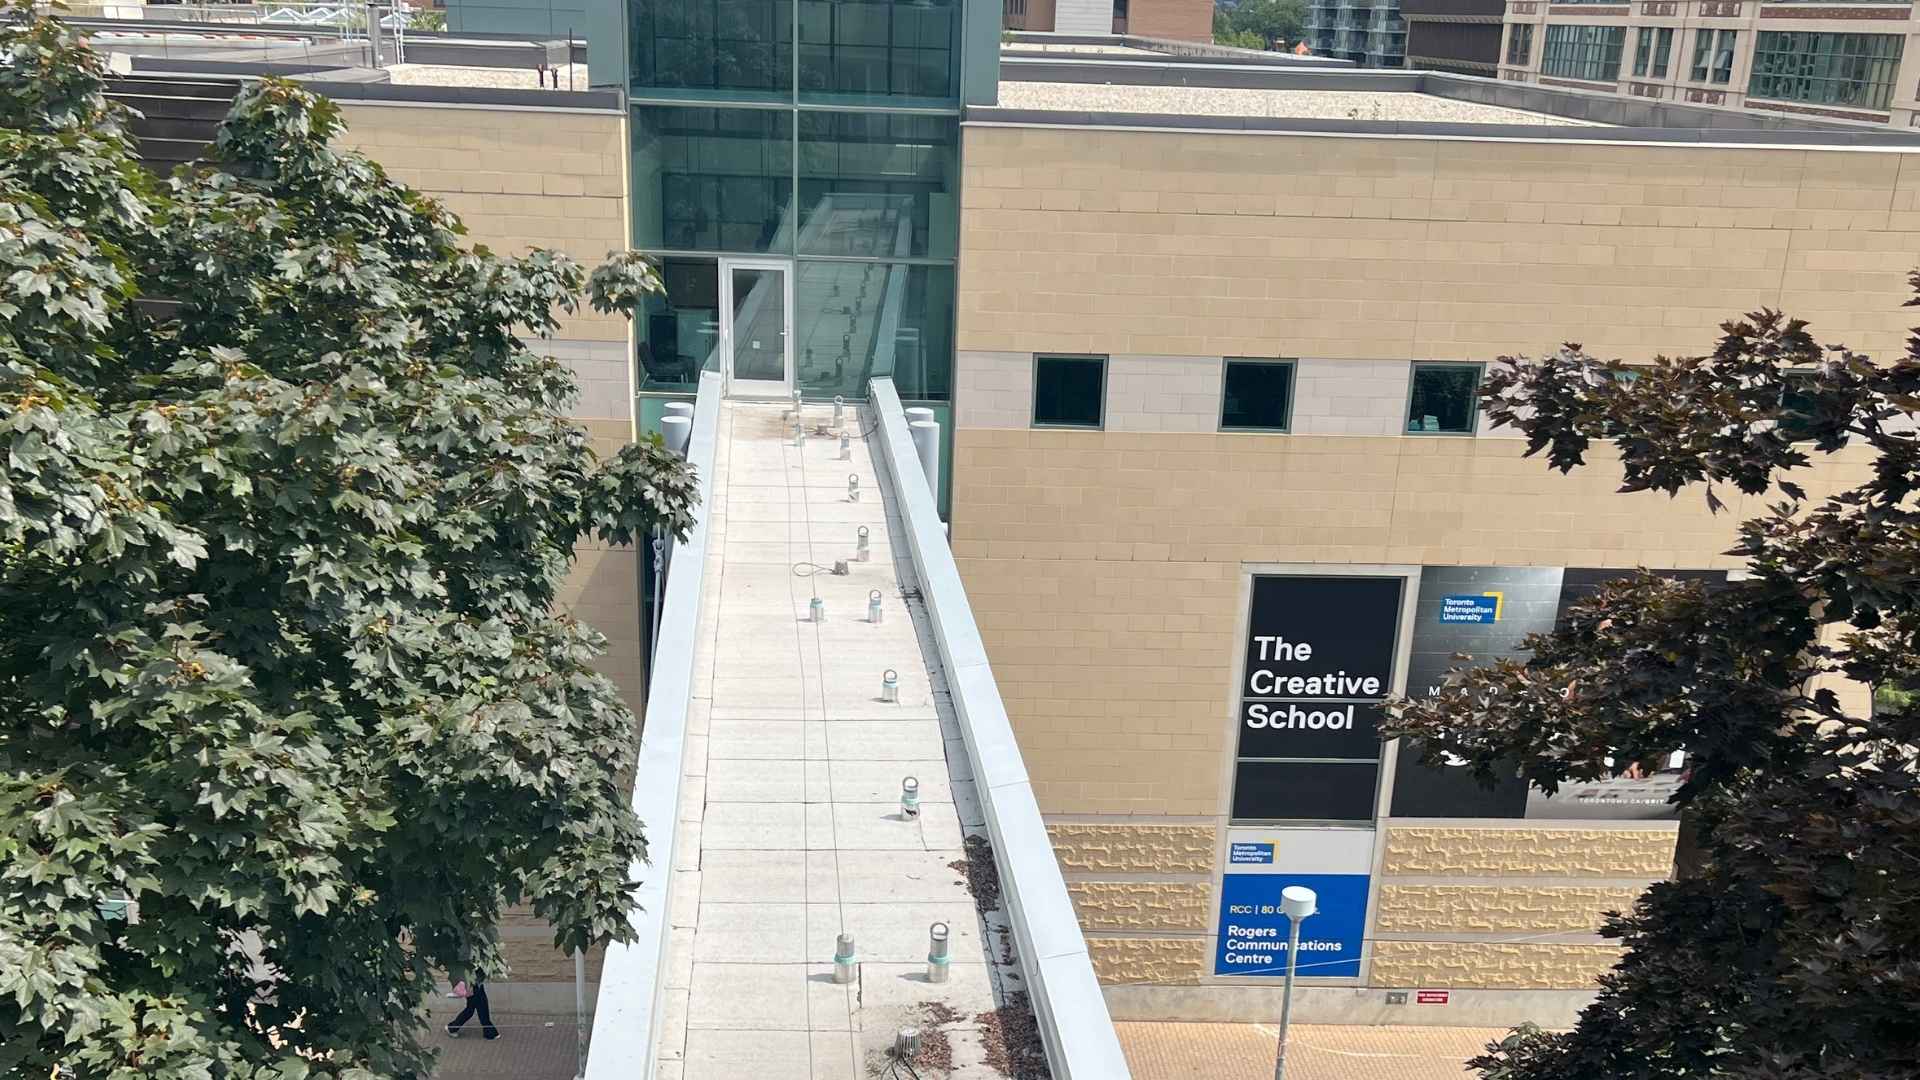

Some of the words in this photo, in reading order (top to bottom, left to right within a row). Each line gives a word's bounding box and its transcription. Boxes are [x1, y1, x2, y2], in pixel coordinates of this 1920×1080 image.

[1445, 598, 1474, 606] Toronto
[1443, 606, 1493, 614] Metropolitan
[1443, 613, 1482, 621] University
[1254, 636, 1312, 661] The
[1250, 669, 1380, 695] Creative
[1246, 704, 1354, 729] School
[1230, 905, 1252, 914] RCC
[1261, 905, 1274, 914] 80
[1228, 925, 1277, 939] Rogers
[1226, 939, 1342, 951] Communcations
[1225, 953, 1272, 964] Centre
